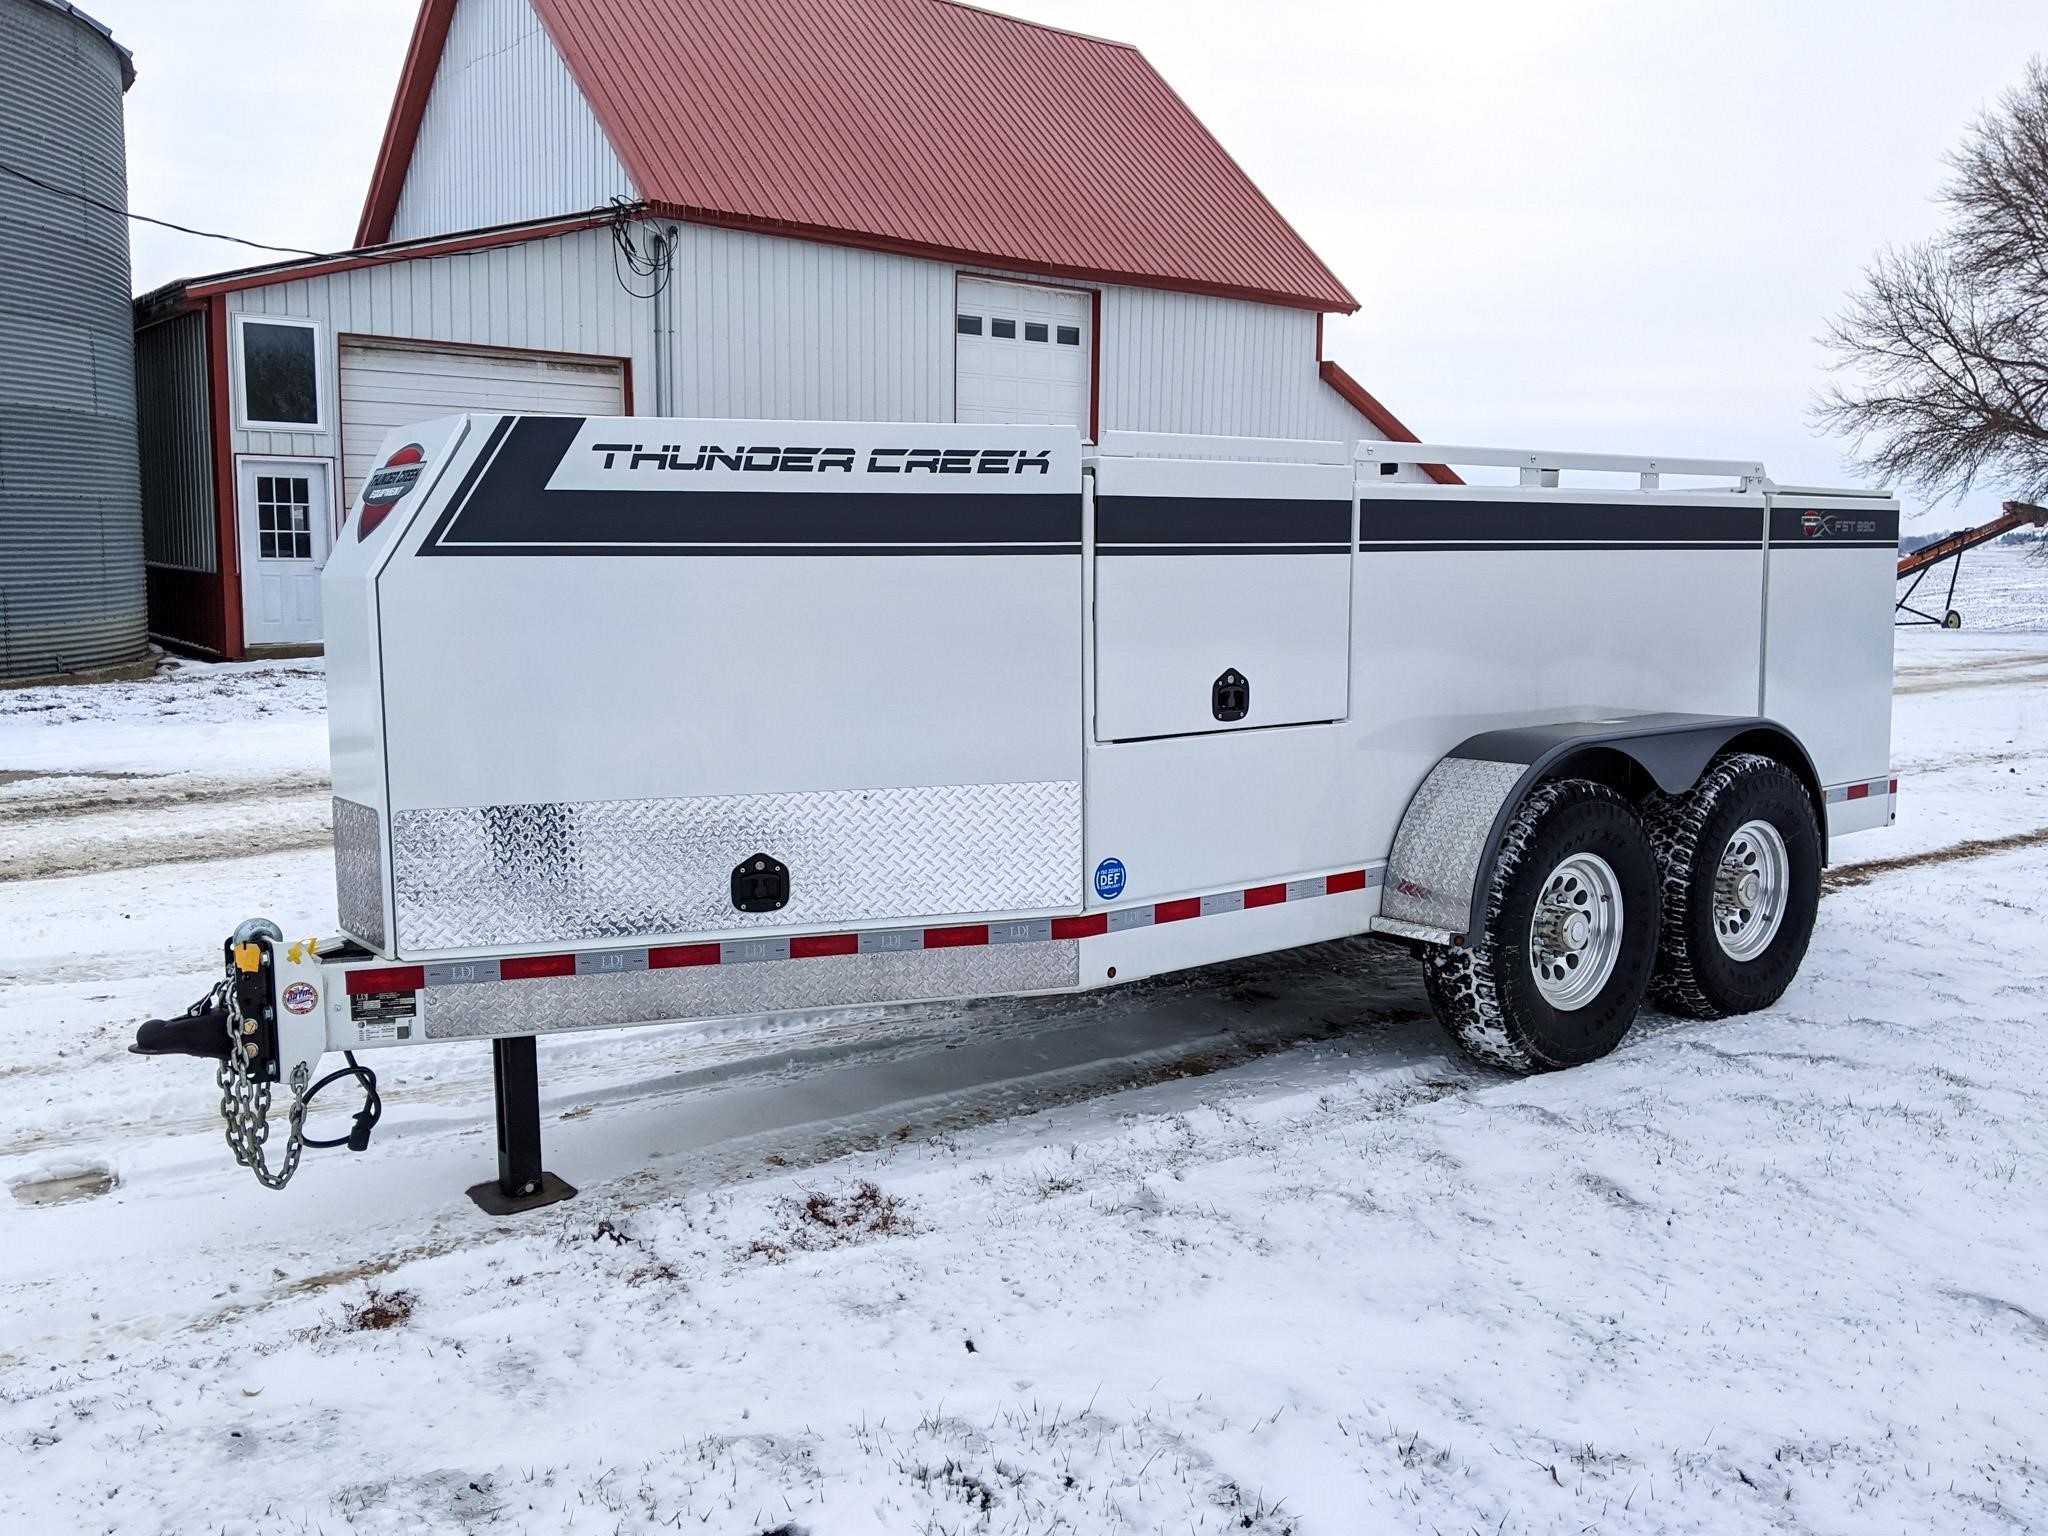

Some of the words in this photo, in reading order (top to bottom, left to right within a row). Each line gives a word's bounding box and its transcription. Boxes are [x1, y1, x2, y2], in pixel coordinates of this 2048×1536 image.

[591, 443, 855, 472] THUNDER
[866, 447, 1052, 474] CREEK
[368, 472, 400, 487] THUNDER
[396, 468, 422, 483] CREEK
[369, 486, 405, 499] EQUIPMENT
[1834, 521, 1856, 532] FST
[1100, 872, 1121, 886] DEF
[1009, 925, 1030, 939] LDJ
[601, 954, 624, 970] LDJ
[452, 966, 475, 980] LDJ
